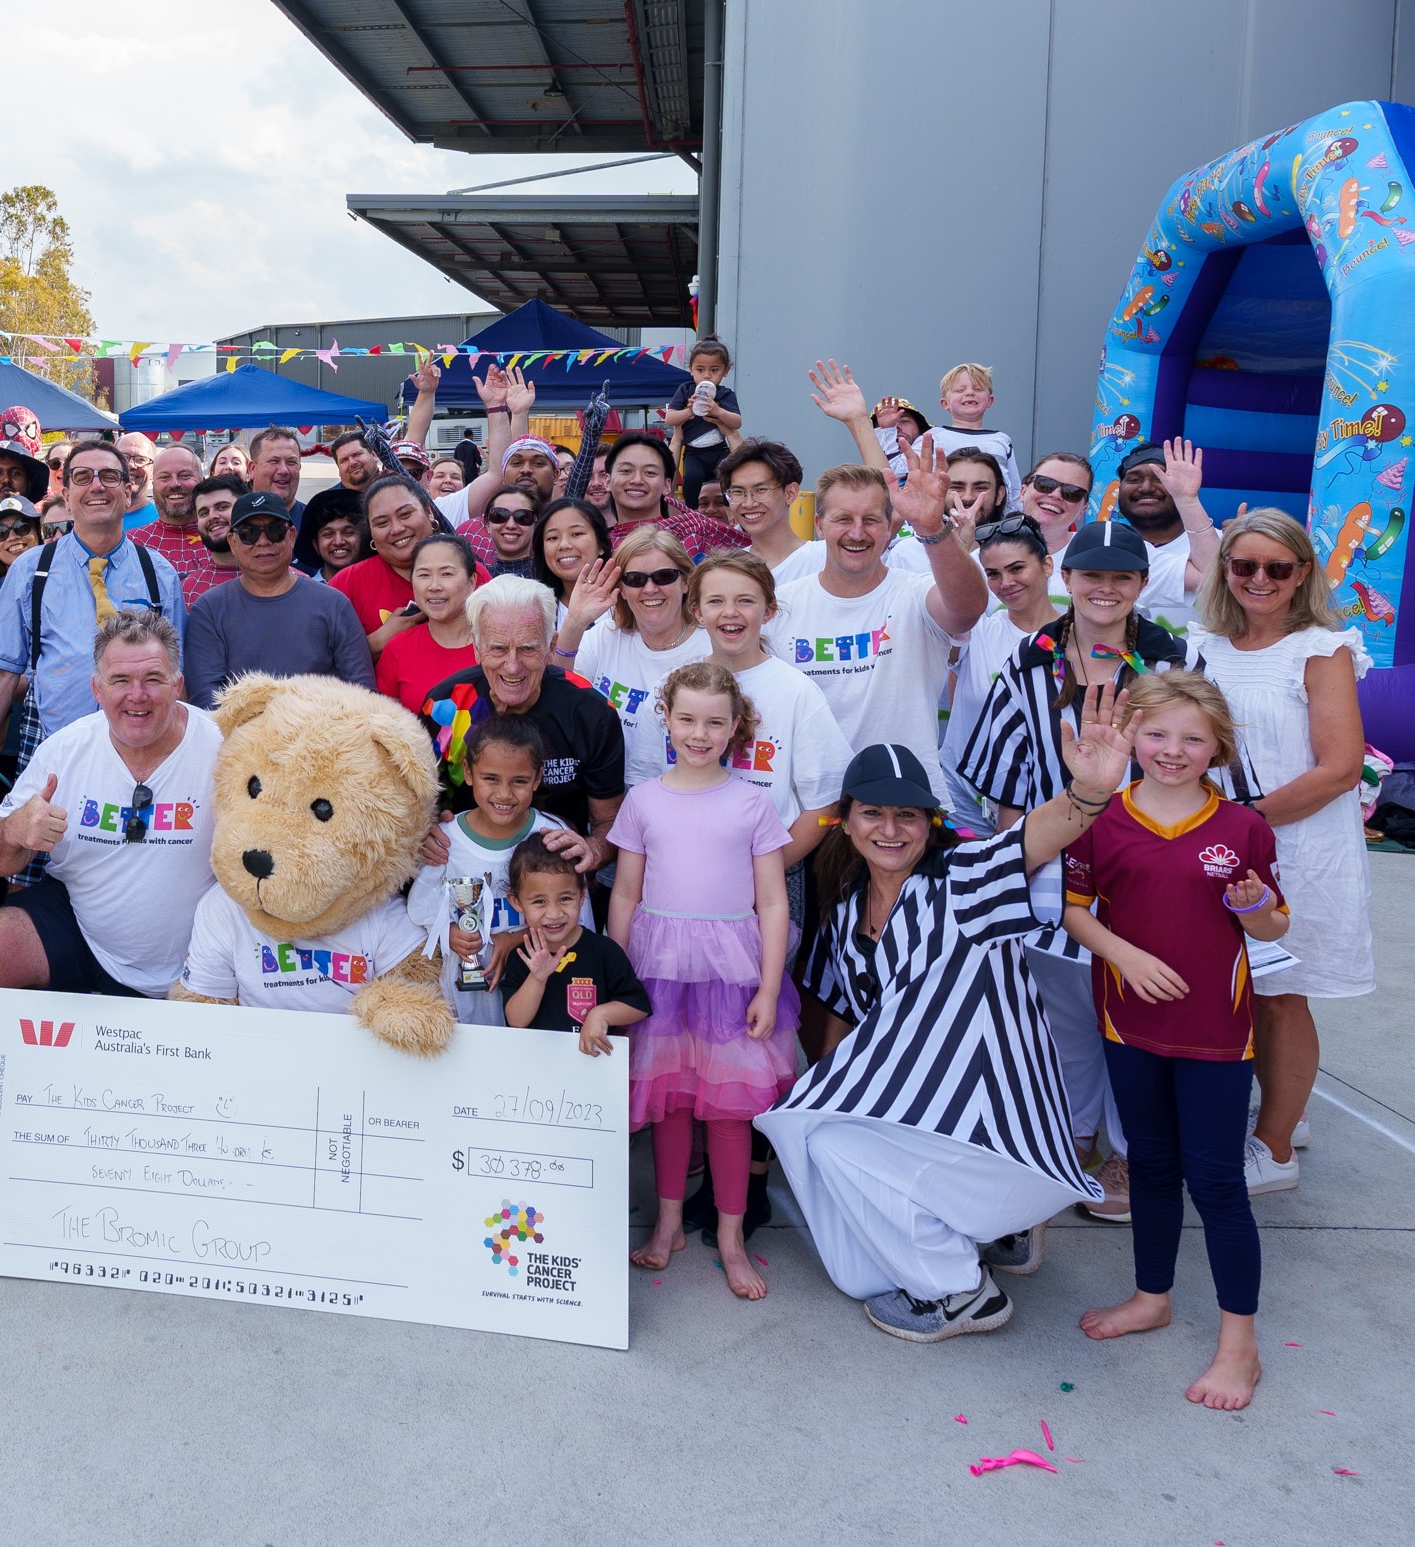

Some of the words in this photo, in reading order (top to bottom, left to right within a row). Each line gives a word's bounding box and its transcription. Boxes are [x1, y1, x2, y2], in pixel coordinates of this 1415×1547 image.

[1341, 237, 1390, 277] Bounce!
[1331, 414, 1383, 440] Time!
[854, 664, 870, 673] kids
[543, 759, 558, 767] THE
[543, 766, 574, 776] CANCER
[543, 773, 577, 785] PROJECT
[77, 833, 120, 846] treatments
[1204, 864, 1233, 875] BRIARS
[262, 943, 368, 984] BETTER
[263, 979, 304, 988] treatments
[305, 976, 318, 985] for
[572, 990, 593, 1000] QLD
[95, 1025, 142, 1040] Westpac
[94, 1039, 151, 1056] Australia's
[156, 1044, 180, 1058] First
[184, 1046, 212, 1060] Bank
[16, 1094, 33, 1103] PAY
[73, 1084, 97, 1109] KIDS
[102, 1088, 145, 1111] CANCER
[151, 1093, 194, 1114] PROJECT
[453, 1105, 478, 1117] DATE
[494, 1085, 603, 1128] 27/09/2023
[368, 1117, 383, 1127] OR
[383, 1118, 420, 1130] BEARER
[13, 1131, 33, 1141] THE
[34, 1132, 55, 1142] SUM
[56, 1134, 70, 1144] OF
[328, 1138, 338, 1160] NOT
[341, 1113, 353, 1183] NEGOTIABLE
[452, 1149, 465, 1171] $
[51, 1204, 90, 1239] THE
[95, 1206, 180, 1254] BROMIC
[192, 1219, 271, 1263] GROUP
[527, 1252, 549, 1265] THE
[551, 1255, 582, 1269] KIDS'
[527, 1264, 572, 1279] CANCER
[526, 1276, 577, 1292] PROJECT
[482, 1290, 510, 1299] SURVIVAL
[512, 1293, 535, 1302] STARTS
[537, 1296, 554, 1304] WITH
